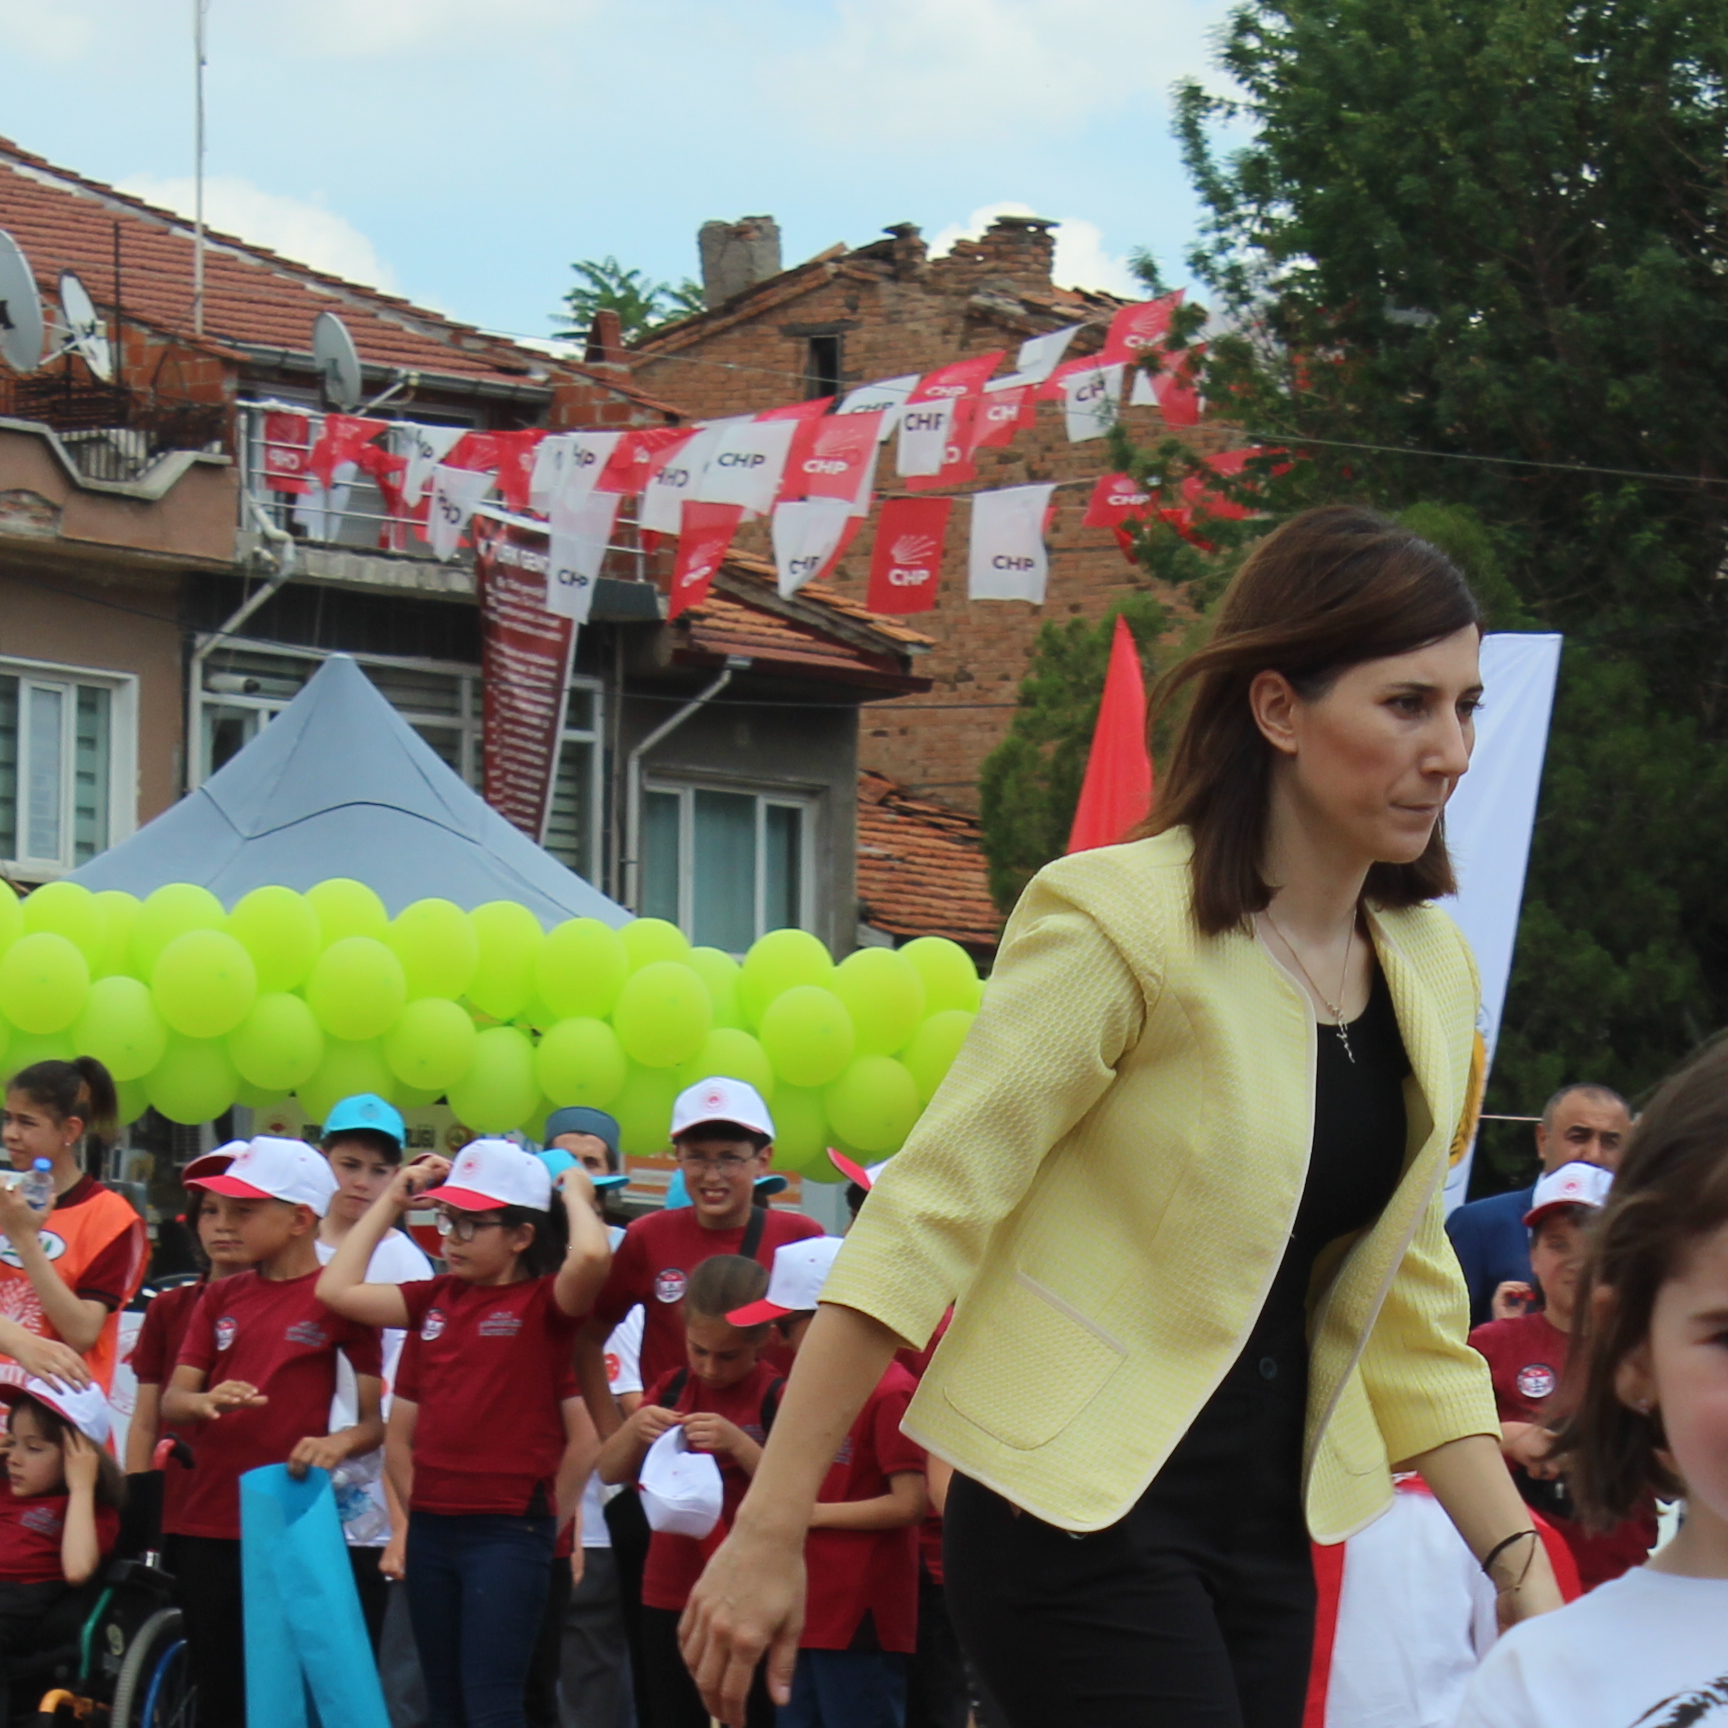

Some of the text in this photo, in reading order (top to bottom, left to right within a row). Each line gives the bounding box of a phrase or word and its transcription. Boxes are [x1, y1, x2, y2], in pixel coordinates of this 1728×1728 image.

[718, 452, 765, 469] CHP
[802, 459, 850, 475] CHP
[991, 554, 1036, 572] CHP
[888, 568, 931, 586] CHP
